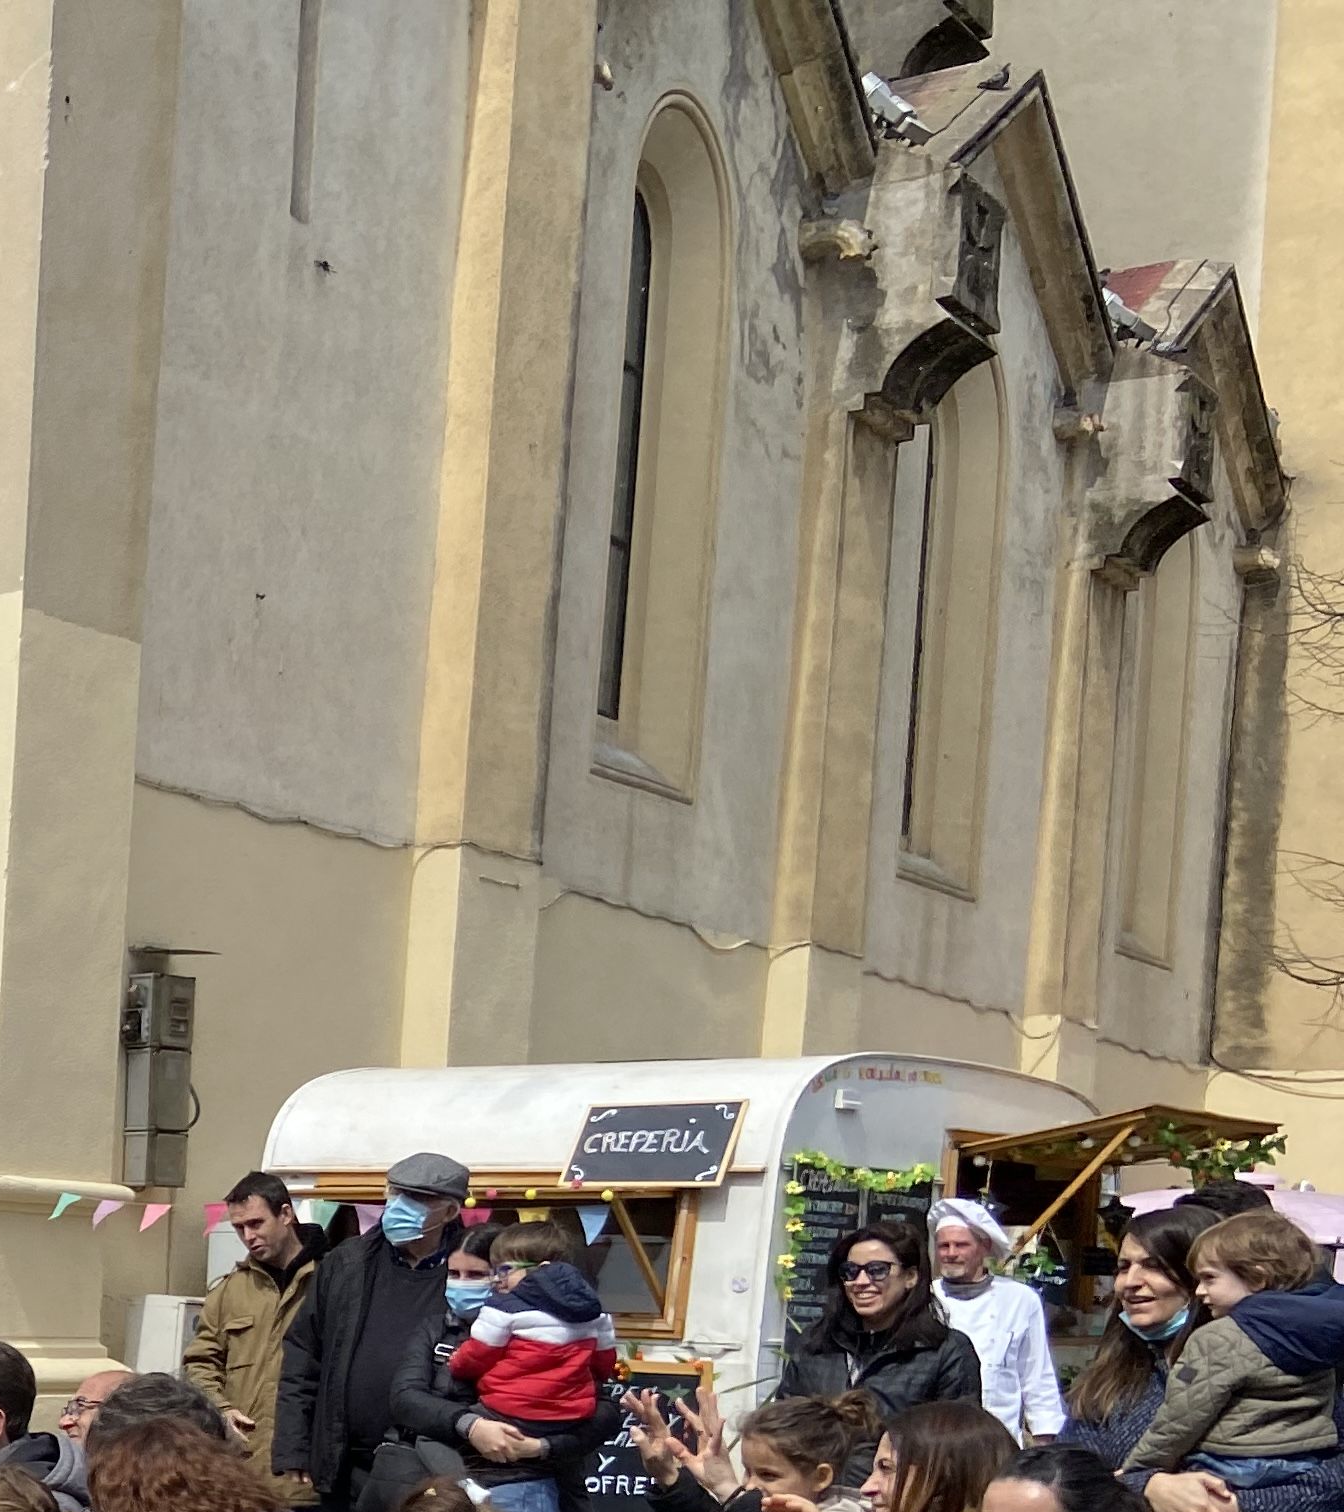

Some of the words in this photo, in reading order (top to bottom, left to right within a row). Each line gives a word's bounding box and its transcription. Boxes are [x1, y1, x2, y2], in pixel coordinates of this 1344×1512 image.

[583, 1118, 710, 1154] CREPERIA
[598, 1452, 617, 1473] Y
[584, 1474, 657, 1497] OFRE
